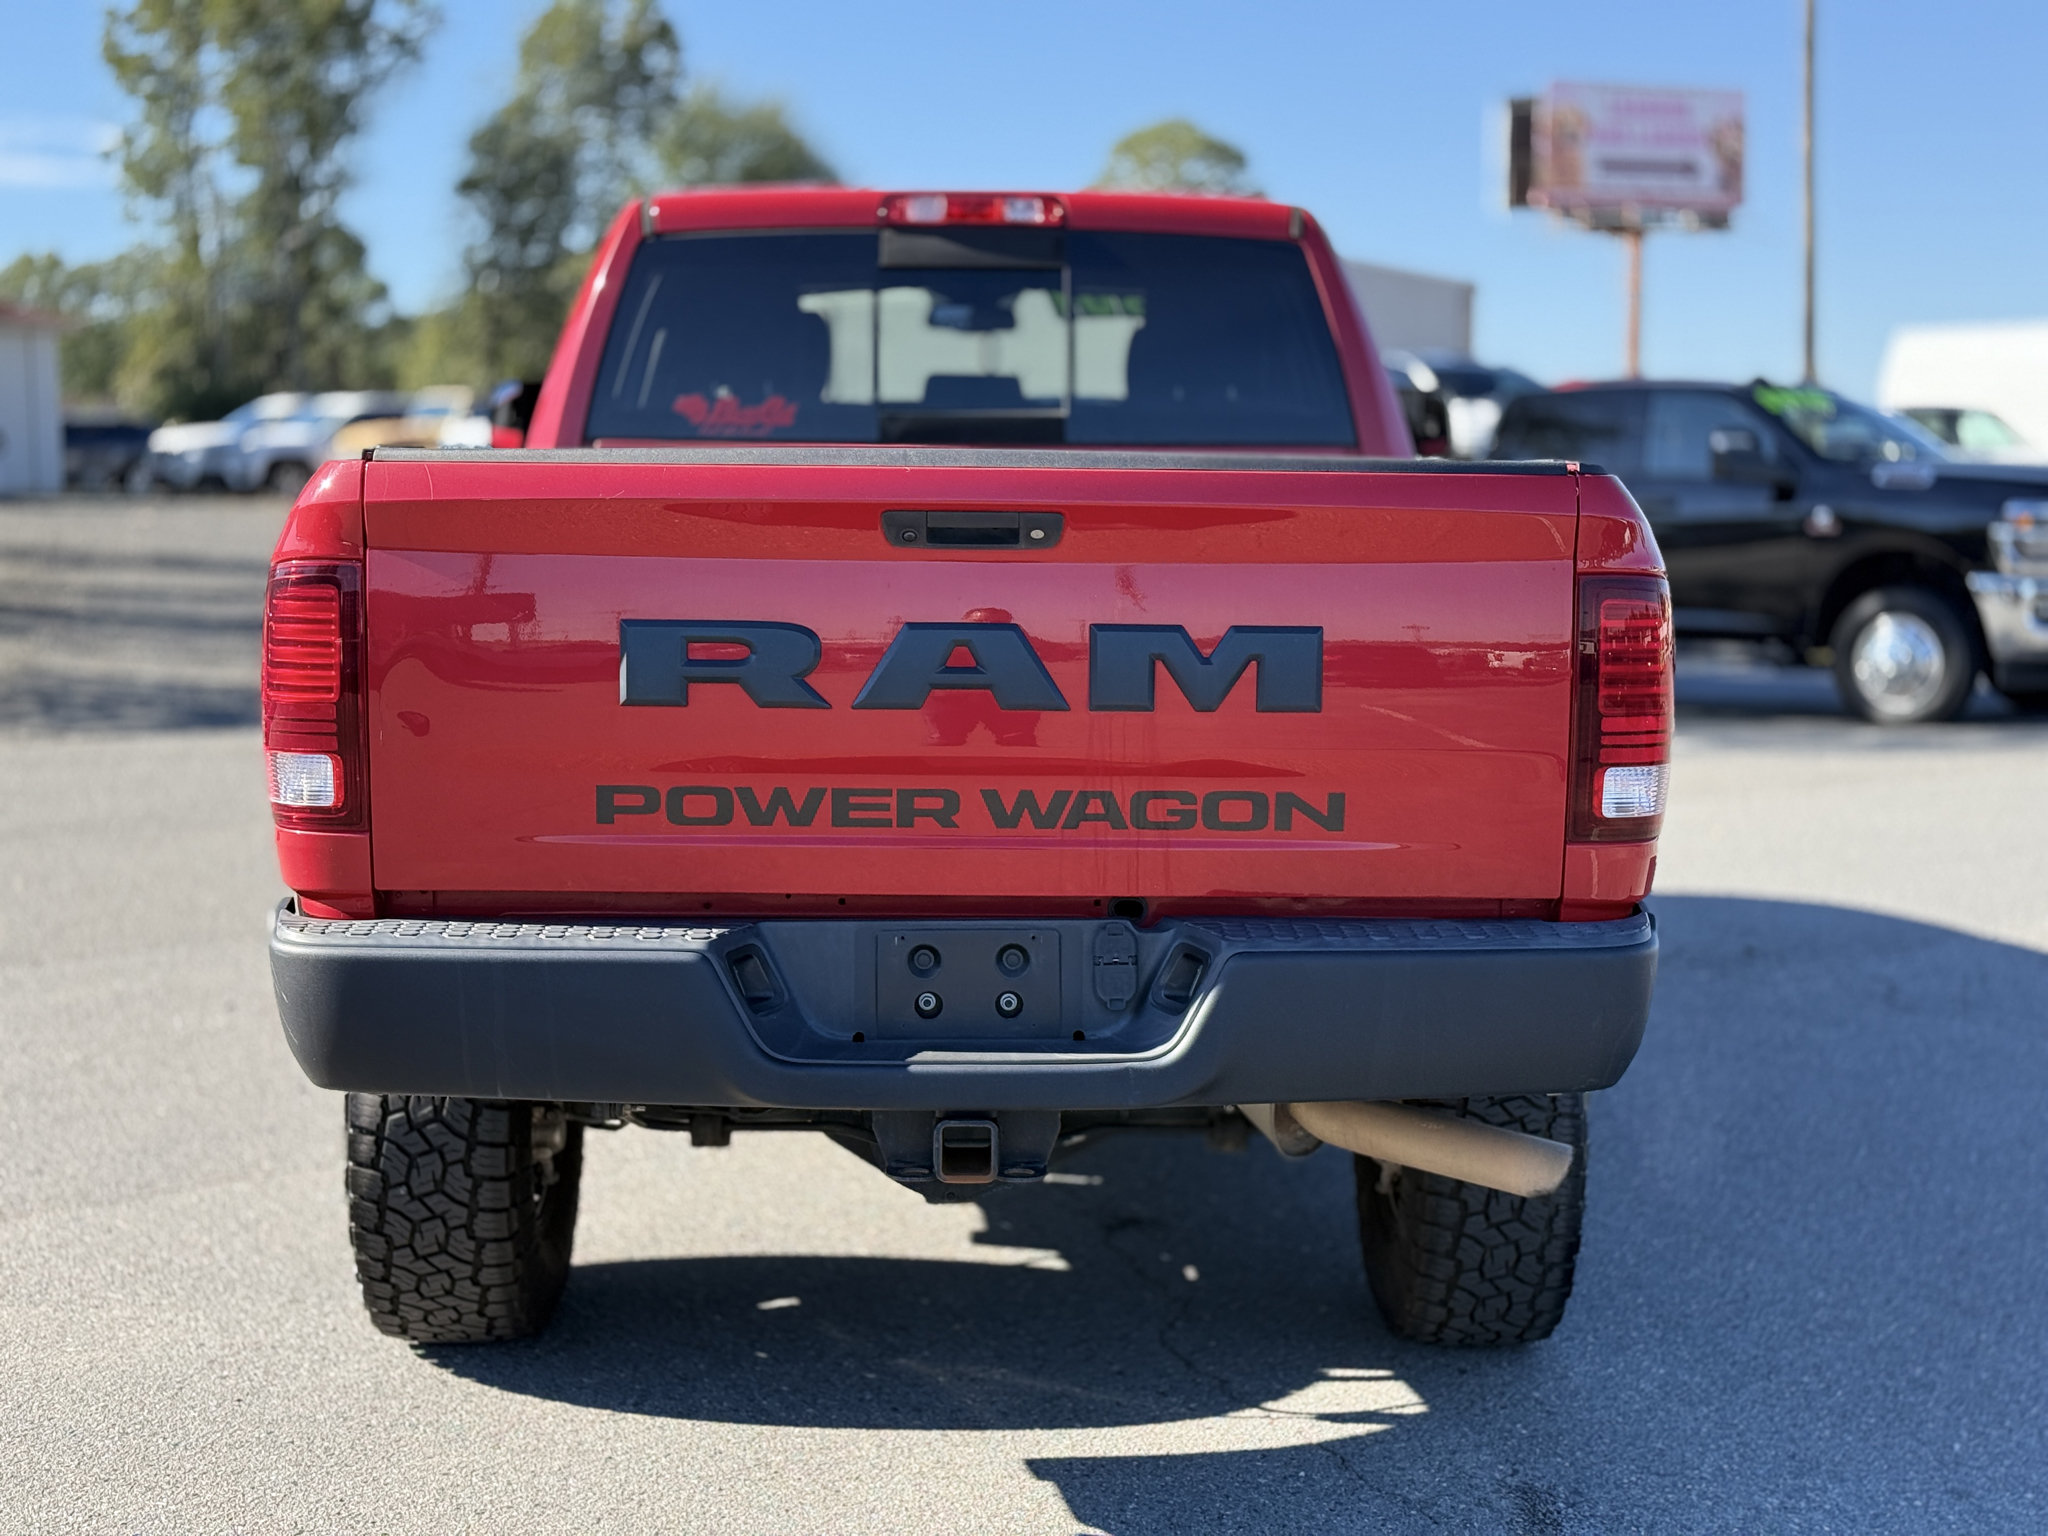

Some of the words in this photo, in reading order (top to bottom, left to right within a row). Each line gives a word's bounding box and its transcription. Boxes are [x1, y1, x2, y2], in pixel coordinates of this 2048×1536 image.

[619, 620, 1324, 712] RAM
[596, 785, 960, 829] POWER
[980, 789, 1346, 832] WAGON
